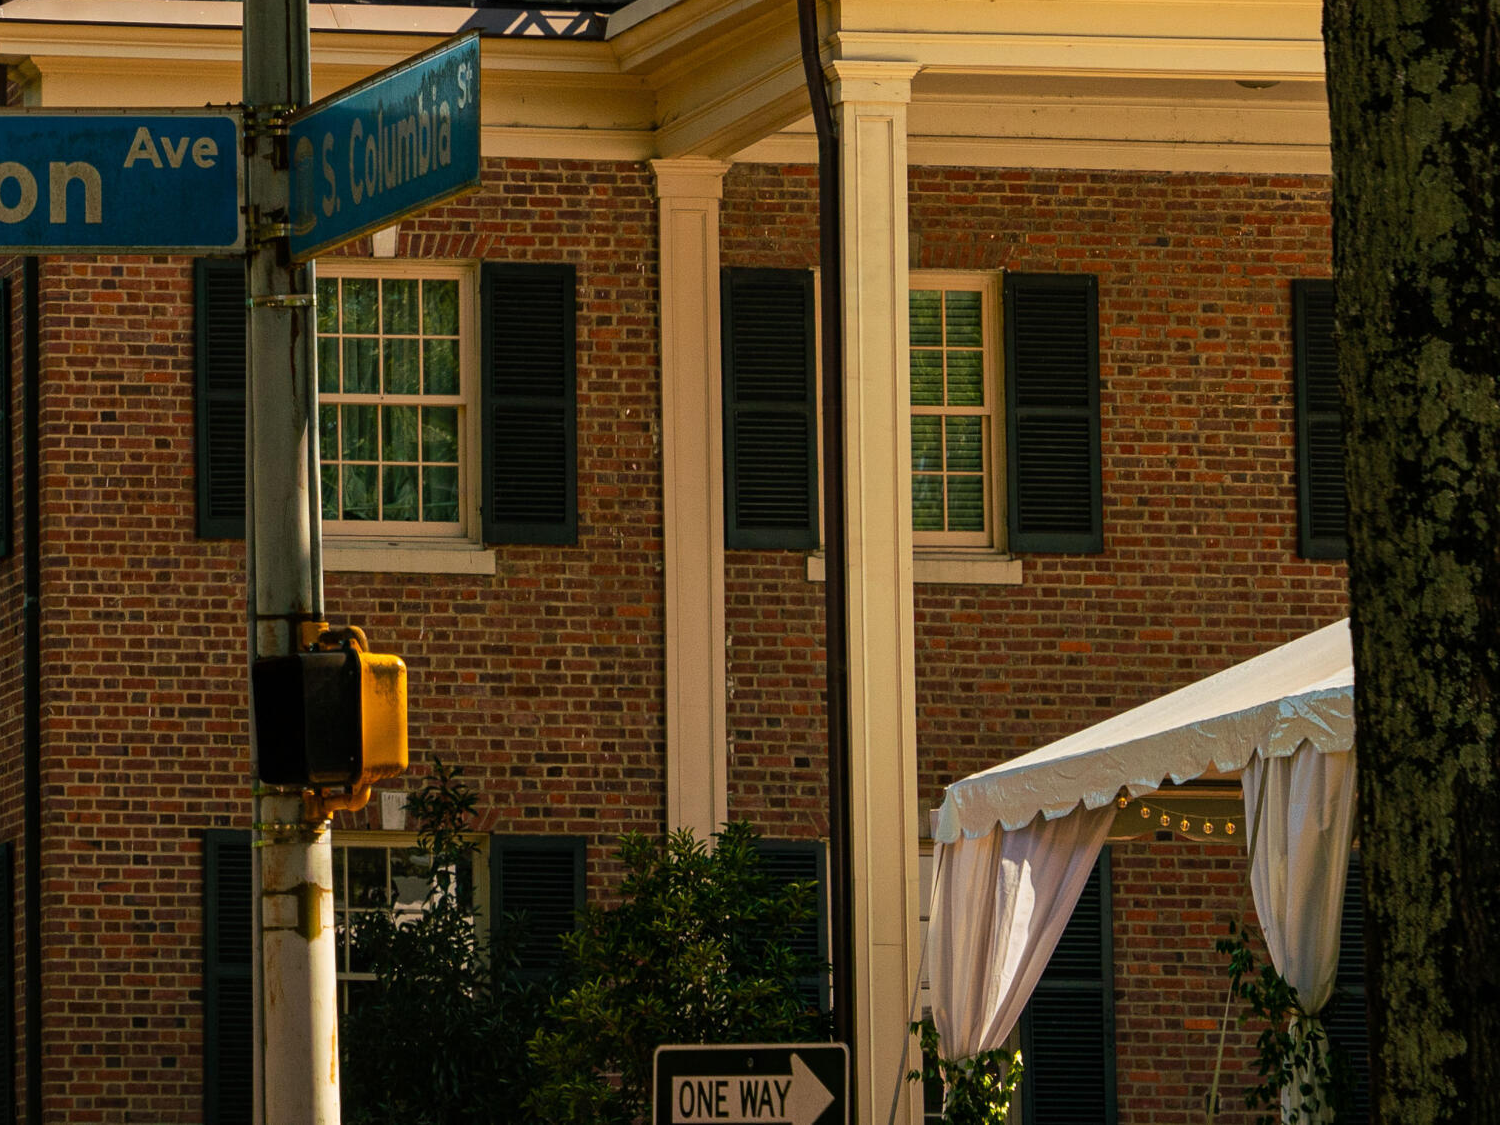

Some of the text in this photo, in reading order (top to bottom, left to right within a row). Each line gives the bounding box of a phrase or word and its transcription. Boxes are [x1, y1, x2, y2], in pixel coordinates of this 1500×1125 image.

[123, 126, 219, 169] Ave
[323, 62, 473, 217] S. Columbia St
[678, 1079, 792, 1119] ONE WAY
